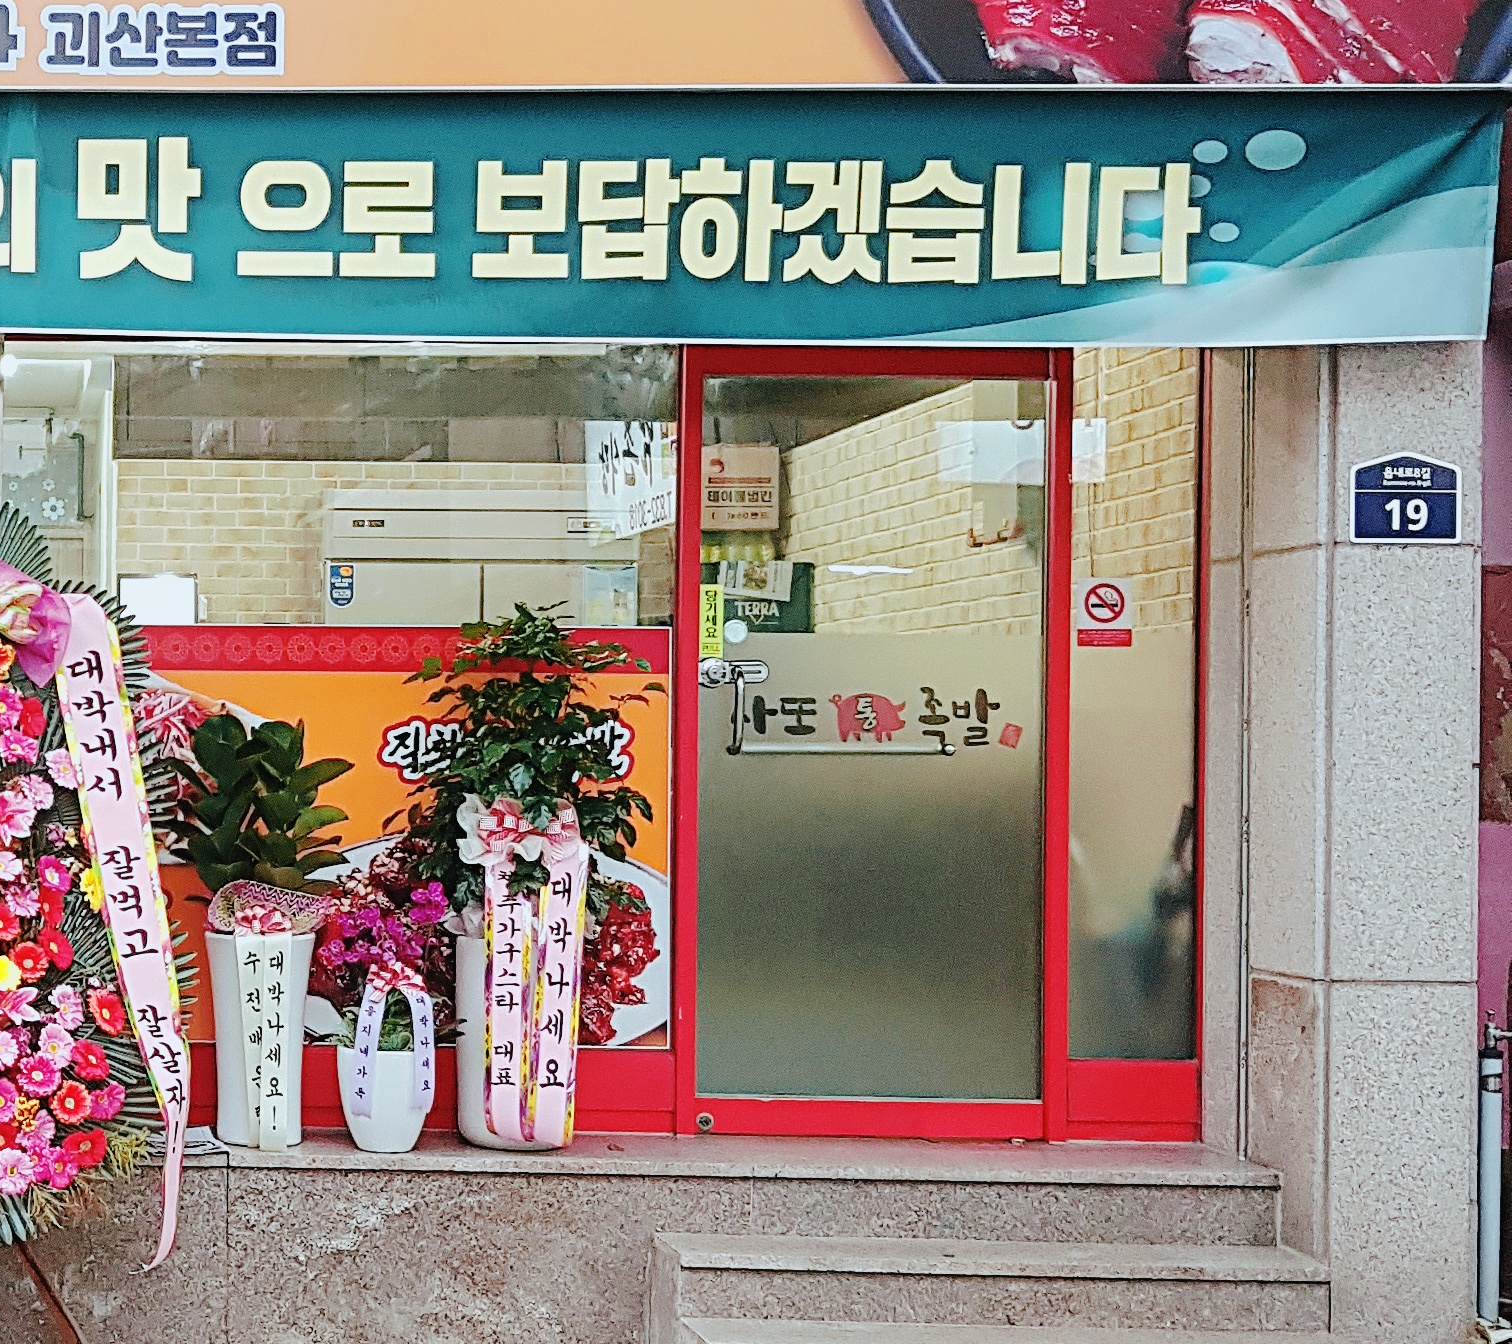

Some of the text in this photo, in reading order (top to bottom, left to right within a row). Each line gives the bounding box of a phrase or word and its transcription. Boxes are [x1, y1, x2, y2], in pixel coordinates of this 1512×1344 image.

[44, 10, 280, 69] 괴산본점
[75, 136, 201, 284] 맛
[236, 159, 437, 281] 으로
[471, 160, 1201, 287] 보답하겠습니다
[1384, 498, 1429, 532] 19
[704, 589, 719, 639] 당기세요
[734, 601, 781, 617] TERRA
[918, 686, 1001, 747] 족발
[65, 650, 187, 1155] 대박내서 잘먹고 잘살자!
[538, 870, 573, 1089] 대박나세요
[264, 949, 285, 1132] 대박나세요!
[491, 1040, 516, 1087] 대표
